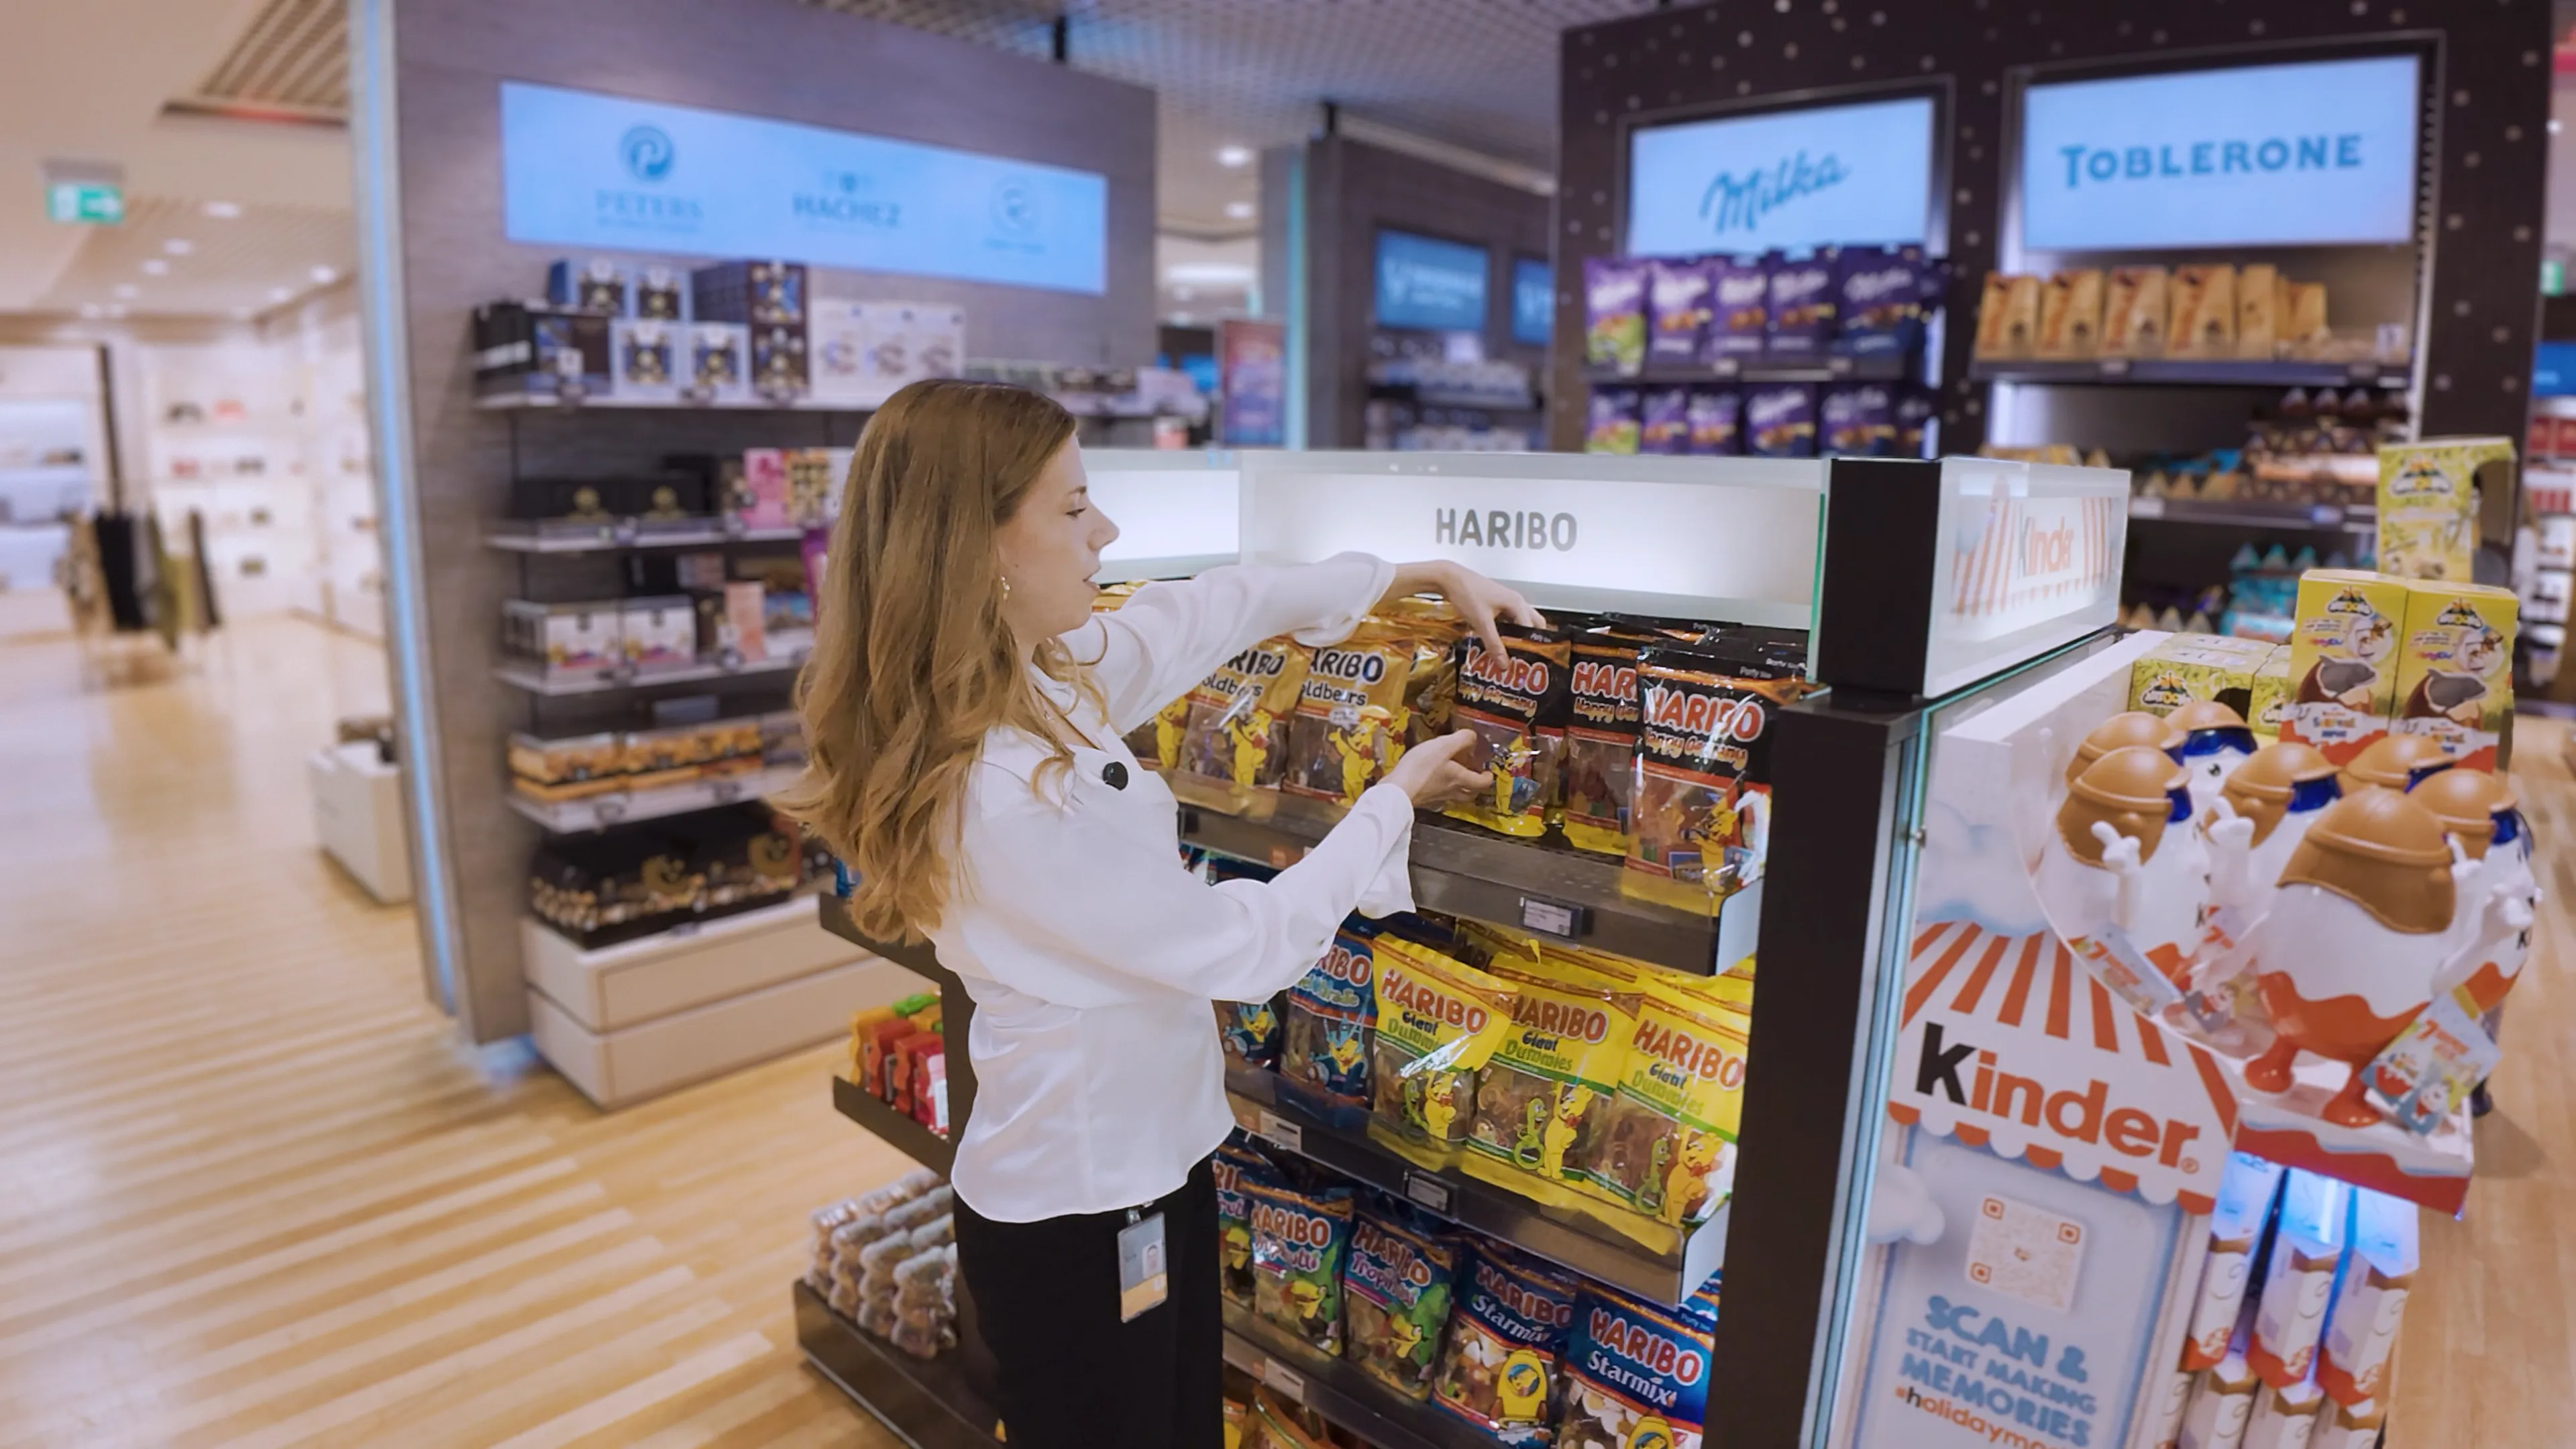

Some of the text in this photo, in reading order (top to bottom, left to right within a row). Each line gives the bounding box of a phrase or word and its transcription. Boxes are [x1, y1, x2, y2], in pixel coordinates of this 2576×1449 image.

[2058, 135, 2363, 189] TOBLERONE
[1699, 149, 1849, 233] Milka
[1436, 507, 1577, 552] HARIBO
[1228, 649, 1284, 675] RIBO
[1572, 663, 1638, 700] HAR
[1382, 969, 1487, 1034] HARIBO
[1403, 1011, 1438, 1035] Giant
[1504, 1038, 1574, 1072] Dummies
[1522, 1030, 1559, 1052] Giant
[1632, 1018, 1746, 1091] HARIBO
[1650, 1063, 1688, 1090] Giant
[1477, 1263, 1572, 1328] HARIBO
[1590, 1307, 1704, 1386] HARIBO
[1925, 1295, 2088, 1383] SCAN &
[1587, 1350, 1673, 1406] Starmix
[1899, 1352, 2091, 1447] MEMORIES
[1907, 1328, 2096, 1415] START MAKING
